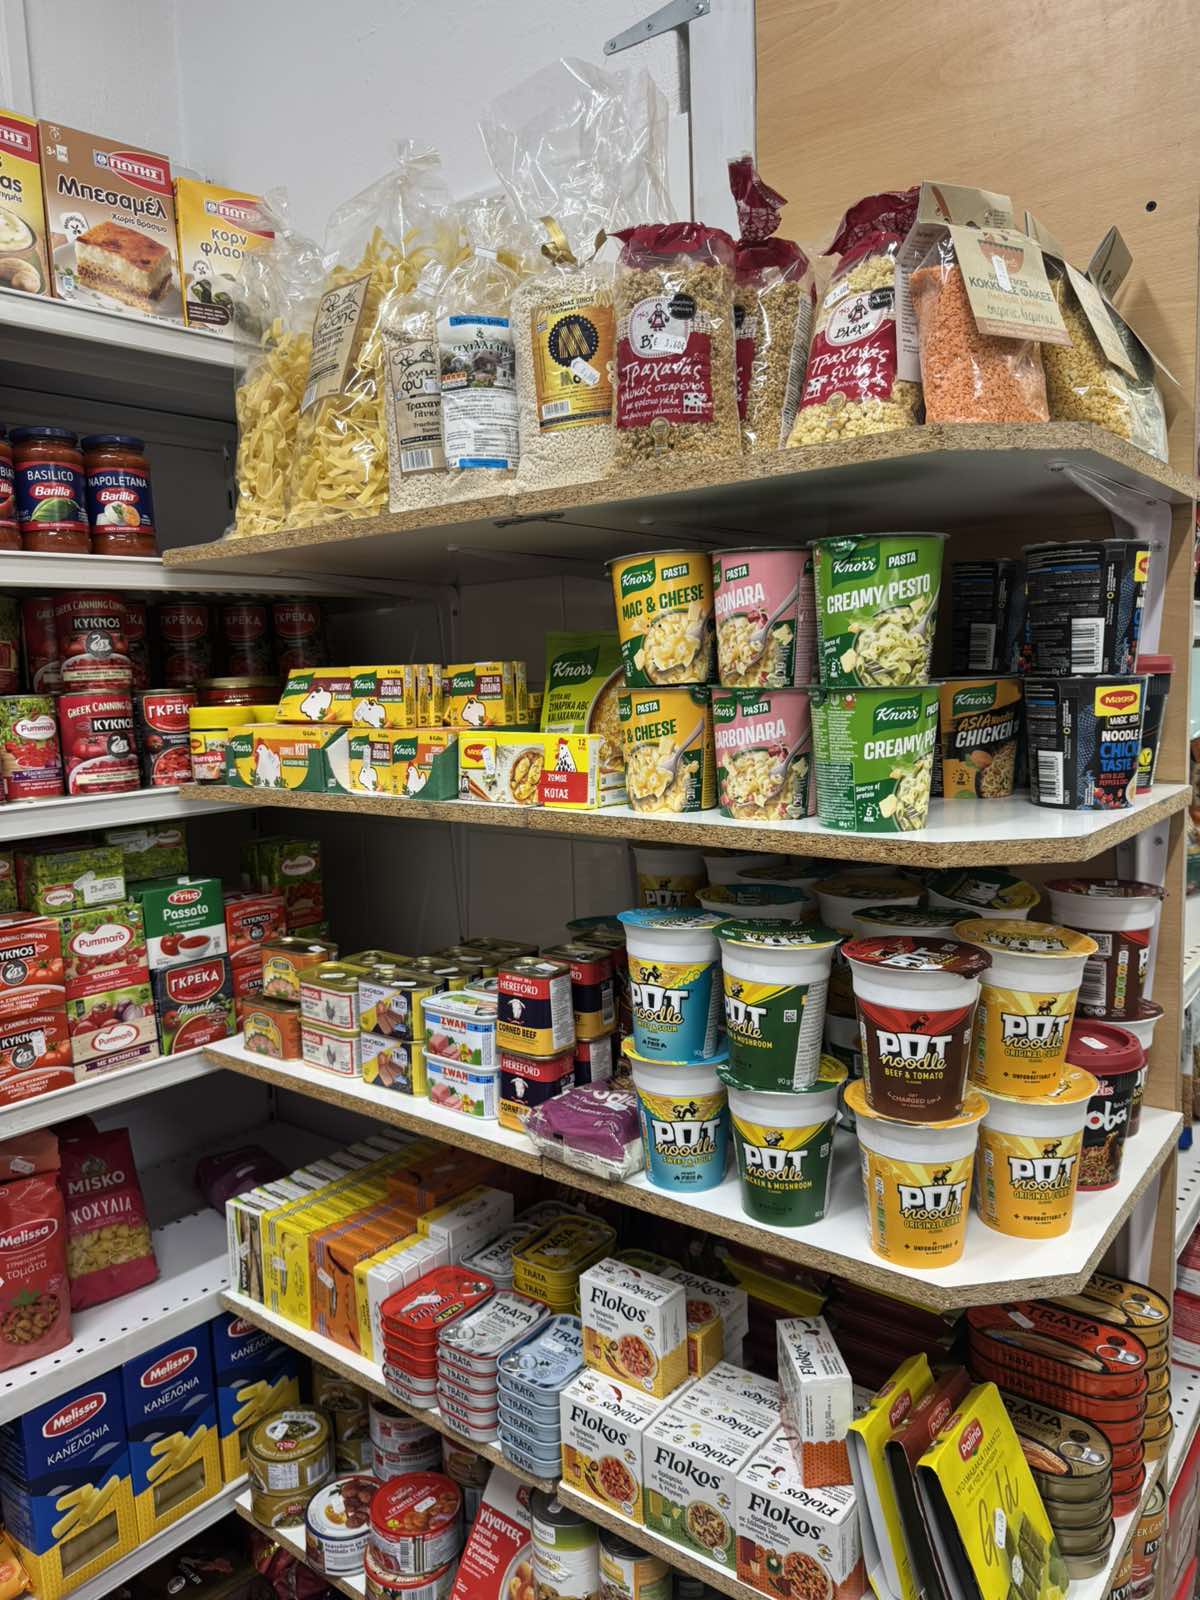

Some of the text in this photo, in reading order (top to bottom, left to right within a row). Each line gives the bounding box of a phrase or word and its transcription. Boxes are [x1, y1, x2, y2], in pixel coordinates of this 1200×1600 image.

[110, 156, 163, 181] ΓΙΩΤΗΣ
[57, 174, 168, 220] Μπεσαμέλ
[211, 228, 248, 246] κορν
[811, 342, 890, 376] Τραχανάς
[622, 357, 702, 387] Τραχανάς
[27, 470, 74, 481] BASILICO
[88, 476, 148, 488] NAPOLETANA
[35, 487, 71, 497] Barilla
[101, 492, 136, 502] Barilla
[833, 551, 917, 574] Knorr PASTA
[622, 564, 689, 587] Knorr PASTA
[726, 568, 748, 580] PASTA
[622, 583, 704, 621] MAC & CHEESE
[826, 573, 931, 615] CREAMY PESTO
[74, 616, 120, 630] KYKNOS
[553, 661, 593, 678] Knorr
[452, 677, 475, 690] Knorr
[67, 700, 126, 719] GREEK CANNING
[637, 703, 659, 715] PASTA
[954, 693, 995, 706] Knorr
[713, 704, 769, 716] Knorr PASTA
[876, 706, 919, 722] Knorr
[627, 719, 677, 744] & CHEESE
[959, 714, 991, 732] ASIA
[578, 738, 586, 747] 12
[714, 720, 786, 749] CARBONARA
[955, 722, 1014, 749] CHICKEN
[394, 744, 416, 756] Knorr
[863, 735, 923, 761] CREAMY
[1102, 758, 1131, 772] TASTE
[547, 774, 568, 783] ΖΩΜΟΣ
[544, 787, 569, 799] ΚΟΤΑΣ
[163, 904, 209, 921] Passata
[170, 971, 220, 993] ΓΚΡΕΚΑ
[499, 980, 539, 996] HEREFORD
[633, 982, 690, 1012] POT
[440, 1015, 467, 1030] ZWAN
[635, 1004, 684, 1025] noodle
[499, 1023, 537, 1040] CORNED BEEF
[1001, 1012, 1072, 1043] POT
[740, 1034, 773, 1049] MUSHROOM
[876, 1029, 953, 1062] POT
[1002, 1031, 1063, 1049] noodle
[879, 1051, 948, 1070] noodle
[1004, 1048, 1042, 1058] ORIGINAL
[442, 1066, 468, 1081] ZWAN
[502, 1057, 541, 1077] HEREFORD
[884, 1066, 944, 1080] BEEF & TOMATO
[892, 1095, 926, 1105] CHARGED
[652, 1120, 721, 1146] POT
[655, 1137, 717, 1156] noodle
[742, 1143, 808, 1173] POT
[746, 1162, 805, 1182] noodle
[1007, 1155, 1078, 1184] POT
[67, 1170, 126, 1196] MISKO
[774, 1180, 812, 1191] MUSHROOM
[1009, 1170, 1073, 1192] noodle
[896, 1180, 967, 1212] POT
[1012, 1190, 1049, 1201] ORIGINAL
[71, 1196, 133, 1226] ΚΟΧΥΛΙΑ
[899, 1201, 962, 1221] noodle
[903, 1219, 942, 1230] ORIGINAL
[0, 1225, 50, 1249] Melissa
[481, 1236, 521, 1262] TRATA
[7, 1257, 47, 1281] τομάτα
[522, 1266, 547, 1283] TRATA
[618, 1280, 662, 1302] Flokos
[671, 1271, 731, 1297] Flokos
[491, 1301, 532, 1326] TRATA
[589, 1286, 648, 1323] Flokos
[1025, 1302, 1099, 1337] TRATA
[149, 1353, 191, 1382] Melissa
[447, 1351, 473, 1369] TRATA
[794, 1343, 817, 1376] Flokos
[446, 1367, 471, 1386] TRATA
[143, 1375, 200, 1415] ΚΑΝΕΛΟΝΙΑ
[390, 1385, 412, 1402] TRATA
[446, 1384, 470, 1403] TRATA
[509, 1380, 536, 1400] TRATA
[52, 1400, 98, 1431] Melissa
[445, 1401, 469, 1420] TRATA
[508, 1399, 533, 1417] TRATA
[600, 1401, 644, 1425] Flokos
[447, 1417, 471, 1436] TRATA
[508, 1416, 535, 1435] TRATA
[569, 1404, 628, 1447] Flokos
[714, 1413, 762, 1439] Flokos
[46, 1423, 110, 1467] ΚΑΝΕΛΟΝΙΑ
[509, 1433, 534, 1451] TRATA
[509, 1452, 534, 1470] TRATA
[687, 1441, 738, 1467] Flokos
[653, 1446, 722, 1490] Flokos
[784, 1487, 839, 1519] Flokos
[747, 1491, 822, 1541] Flokos
[479, 1507, 524, 1547] γίγαντες
